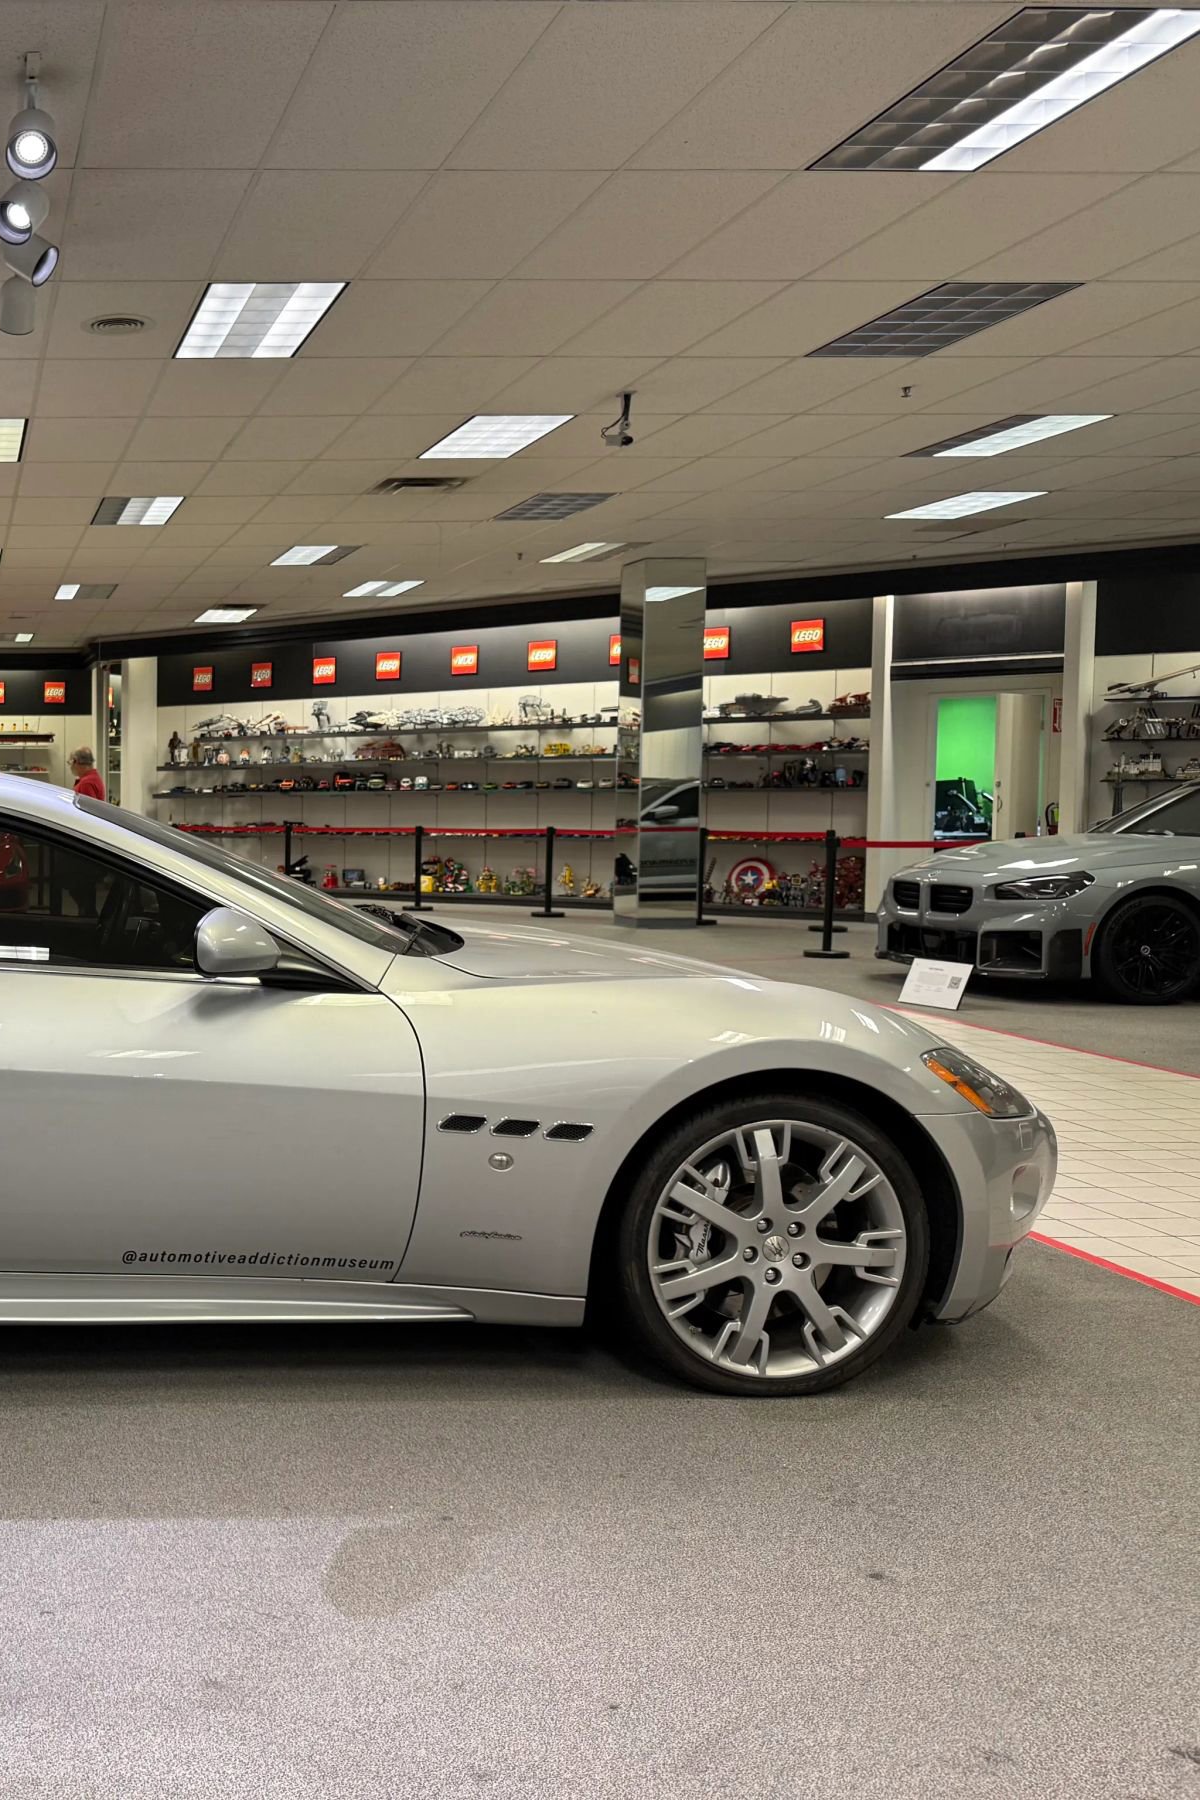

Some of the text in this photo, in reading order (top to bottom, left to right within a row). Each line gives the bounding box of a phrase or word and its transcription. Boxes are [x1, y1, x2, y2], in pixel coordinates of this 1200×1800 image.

[794, 629, 820, 642] LEGO
[531, 650, 553, 662] LEGO
[315, 665, 334, 677] LEGO
[378, 660, 399, 671] LEGO
[195, 674, 212, 683] LEGO
[253, 670, 271, 680] LEGO
[45, 688, 64, 697] LEGO
[122, 1250, 395, 1270] @automotiveaddictionmuseum
